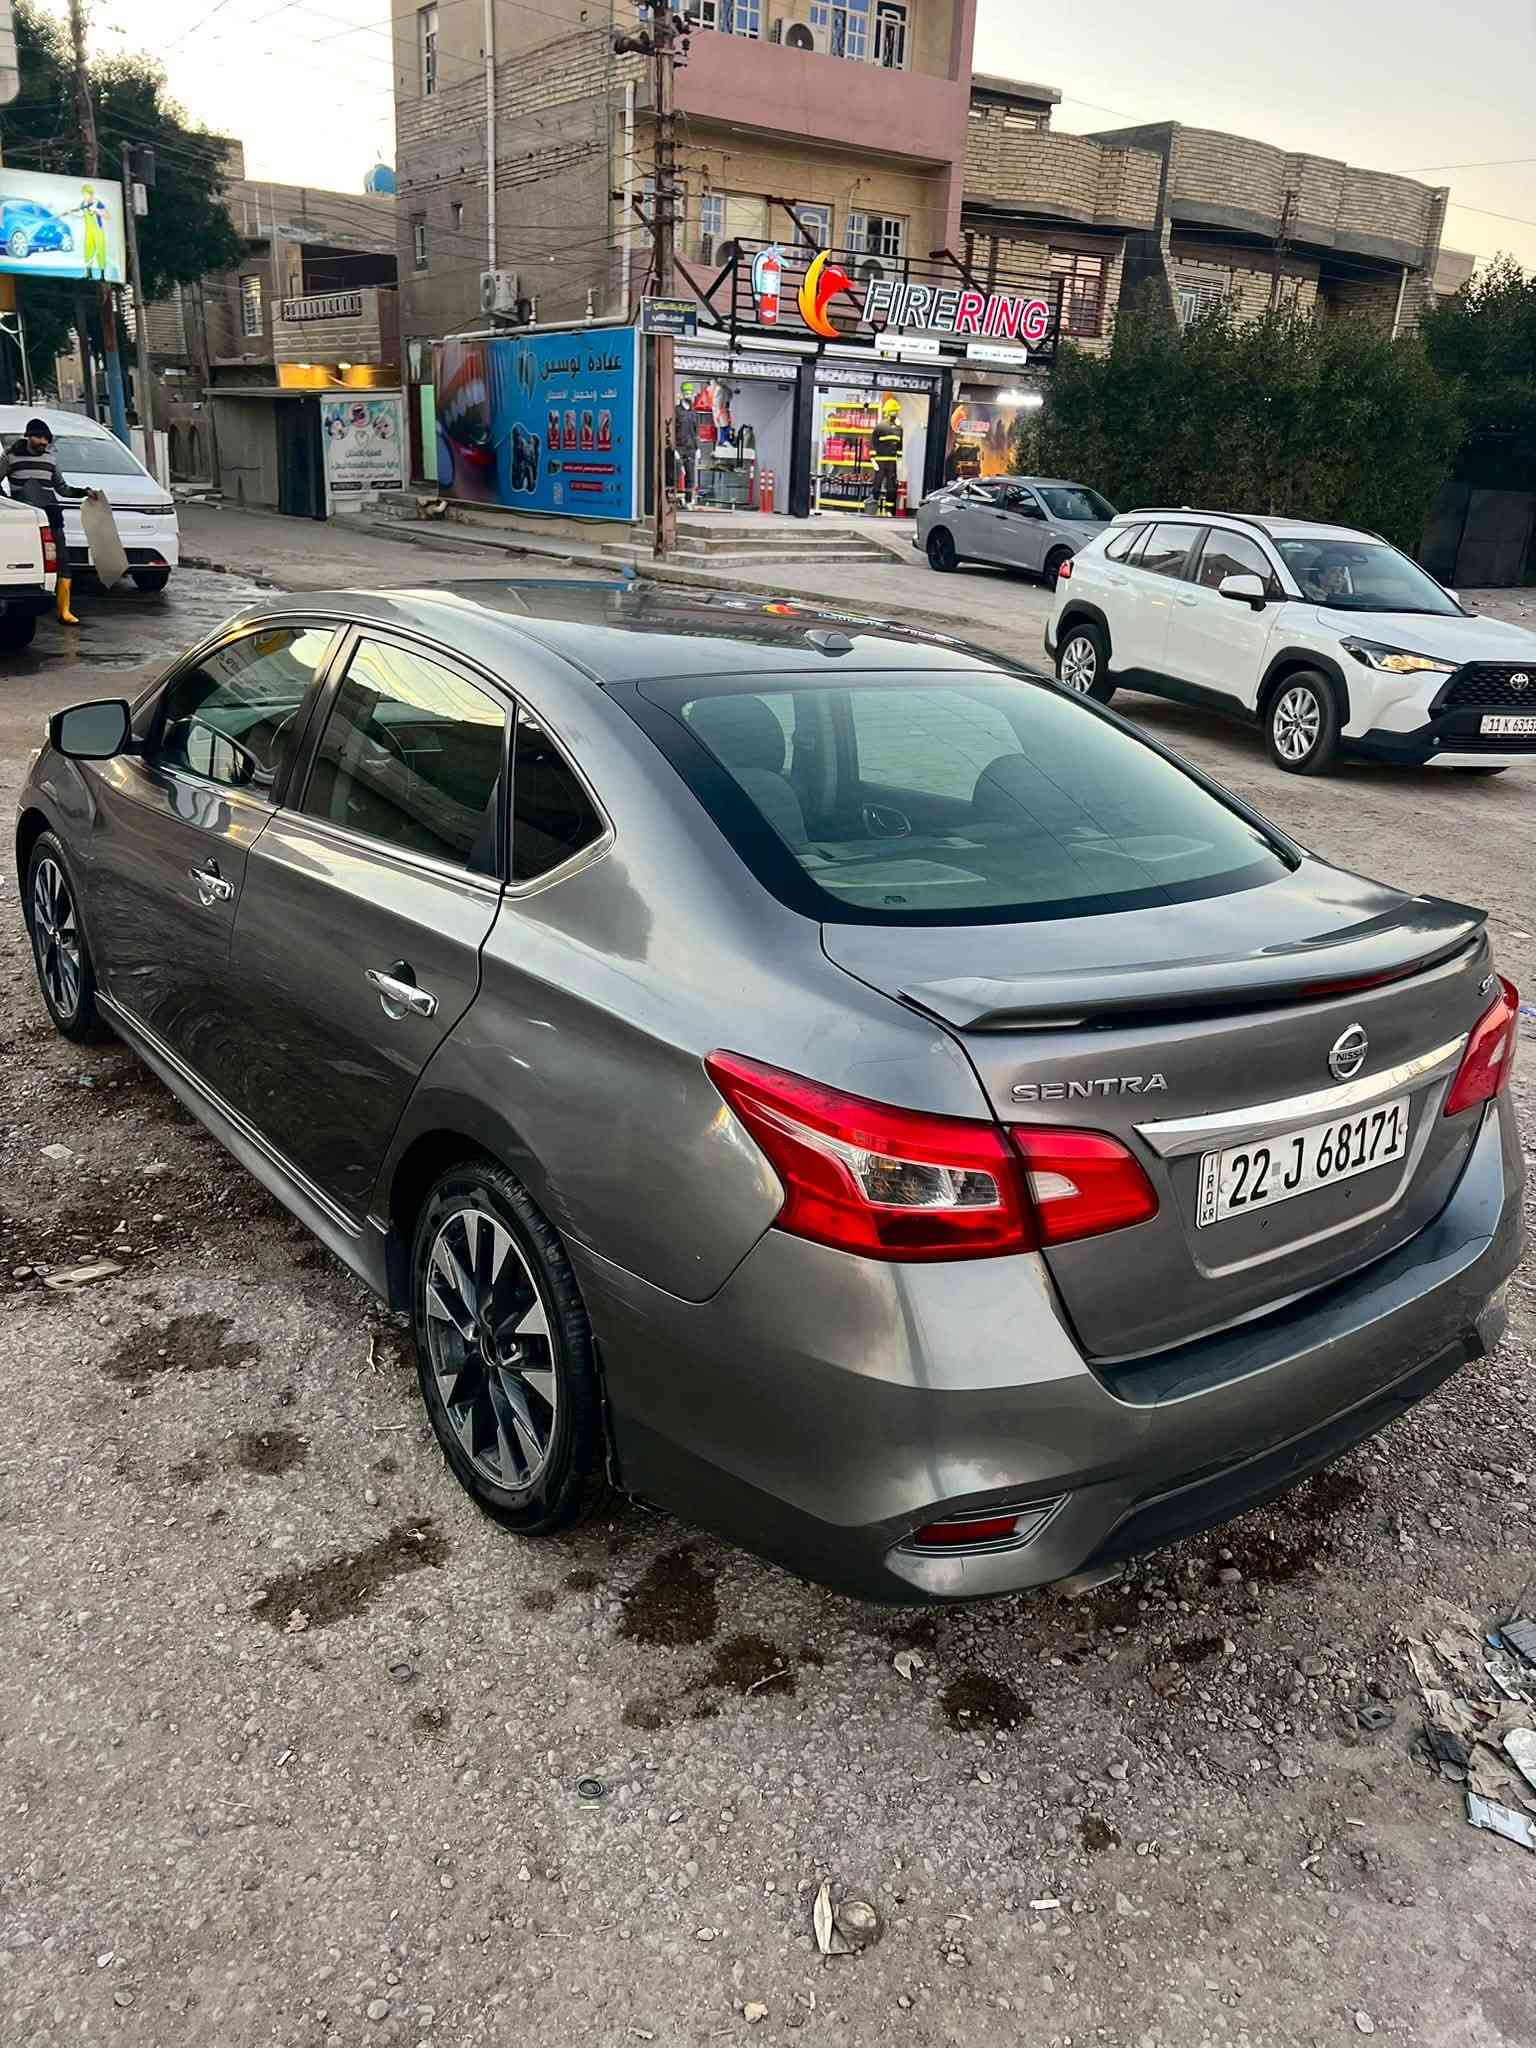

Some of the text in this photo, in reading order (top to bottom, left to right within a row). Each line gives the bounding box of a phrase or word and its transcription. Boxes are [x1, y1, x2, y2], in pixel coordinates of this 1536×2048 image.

[862, 278, 1050, 341] FIRERING
[588, 347, 623, 377] عيادة
[1011, 1073, 1169, 1103] SENTRA
[1229, 1105, 1400, 1208] 22 J 68171
